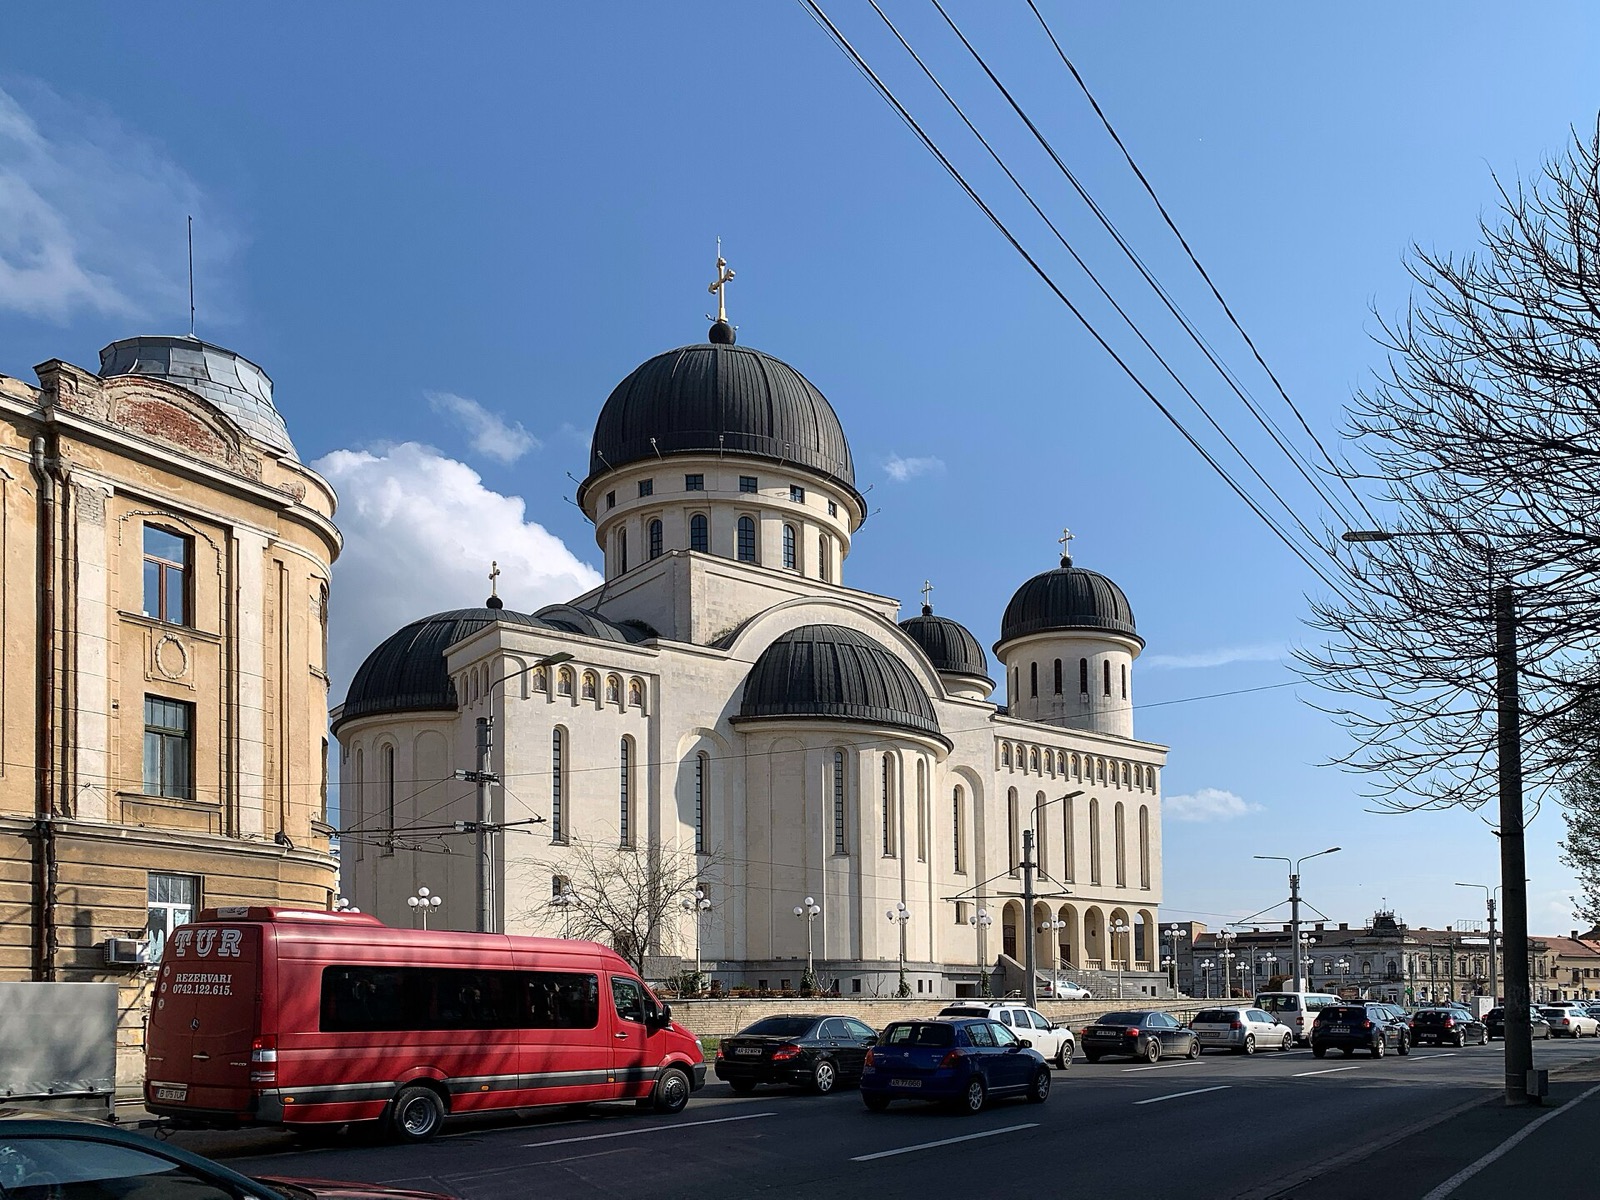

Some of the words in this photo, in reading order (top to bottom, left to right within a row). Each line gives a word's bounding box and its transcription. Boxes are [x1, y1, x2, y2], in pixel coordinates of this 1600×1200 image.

[174, 929, 243, 957] TUR
[175, 973, 232, 983] REZERVARI
[172, 984, 233, 996] 0742.122.615.
